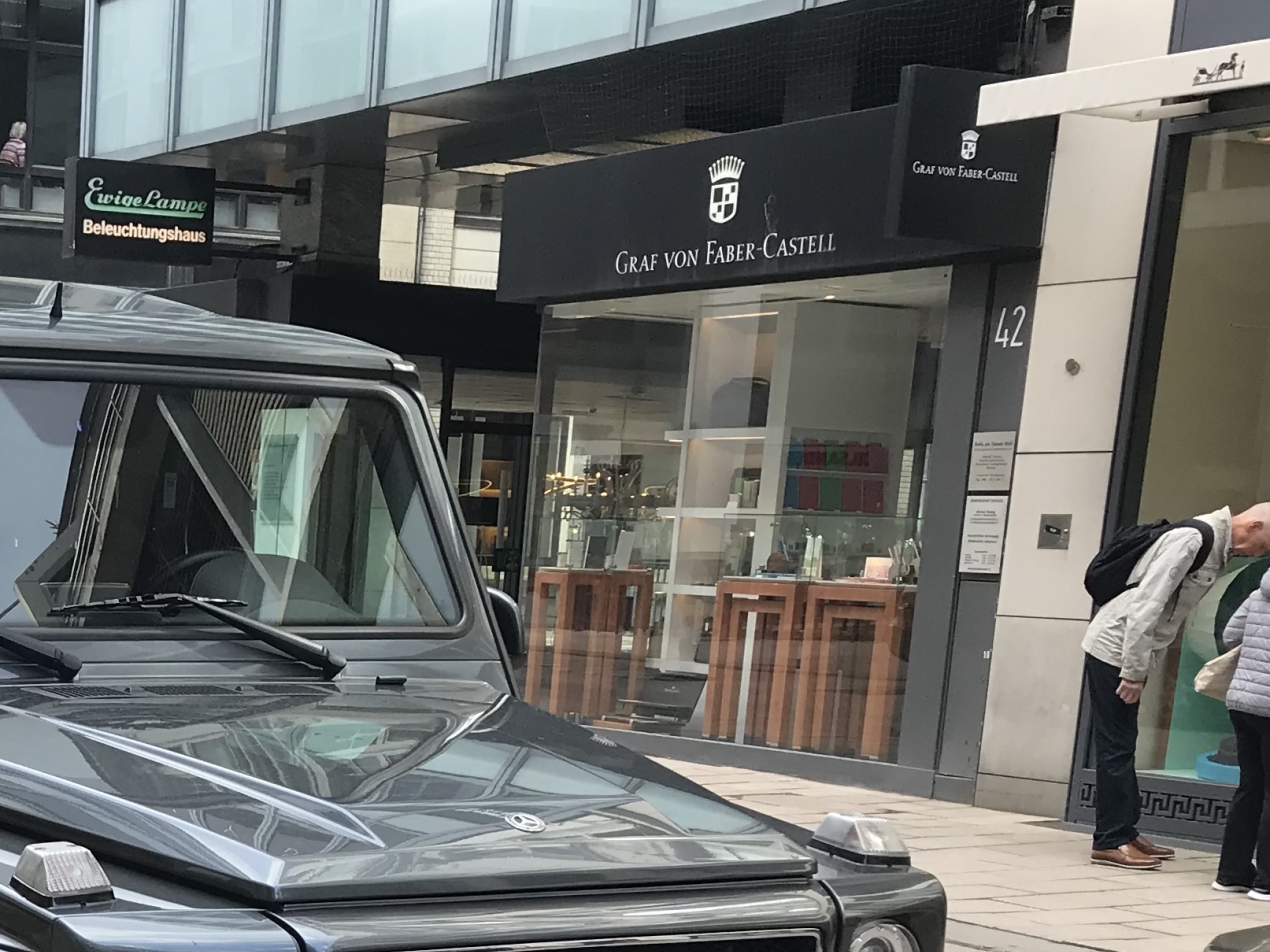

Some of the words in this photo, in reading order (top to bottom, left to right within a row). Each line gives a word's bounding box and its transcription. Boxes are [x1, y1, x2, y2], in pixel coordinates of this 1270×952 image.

[912, 161, 936, 174] GRAF
[938, 166, 956, 176] VON
[958, 165, 1018, 182] FABER-CASTELL
[83, 219, 206, 243] Beleuchtungshaus
[615, 250, 659, 274] GRAF
[664, 248, 699, 269] VON
[705, 232, 837, 265] FABER-CASTELL
[994, 305, 1026, 348] 42
